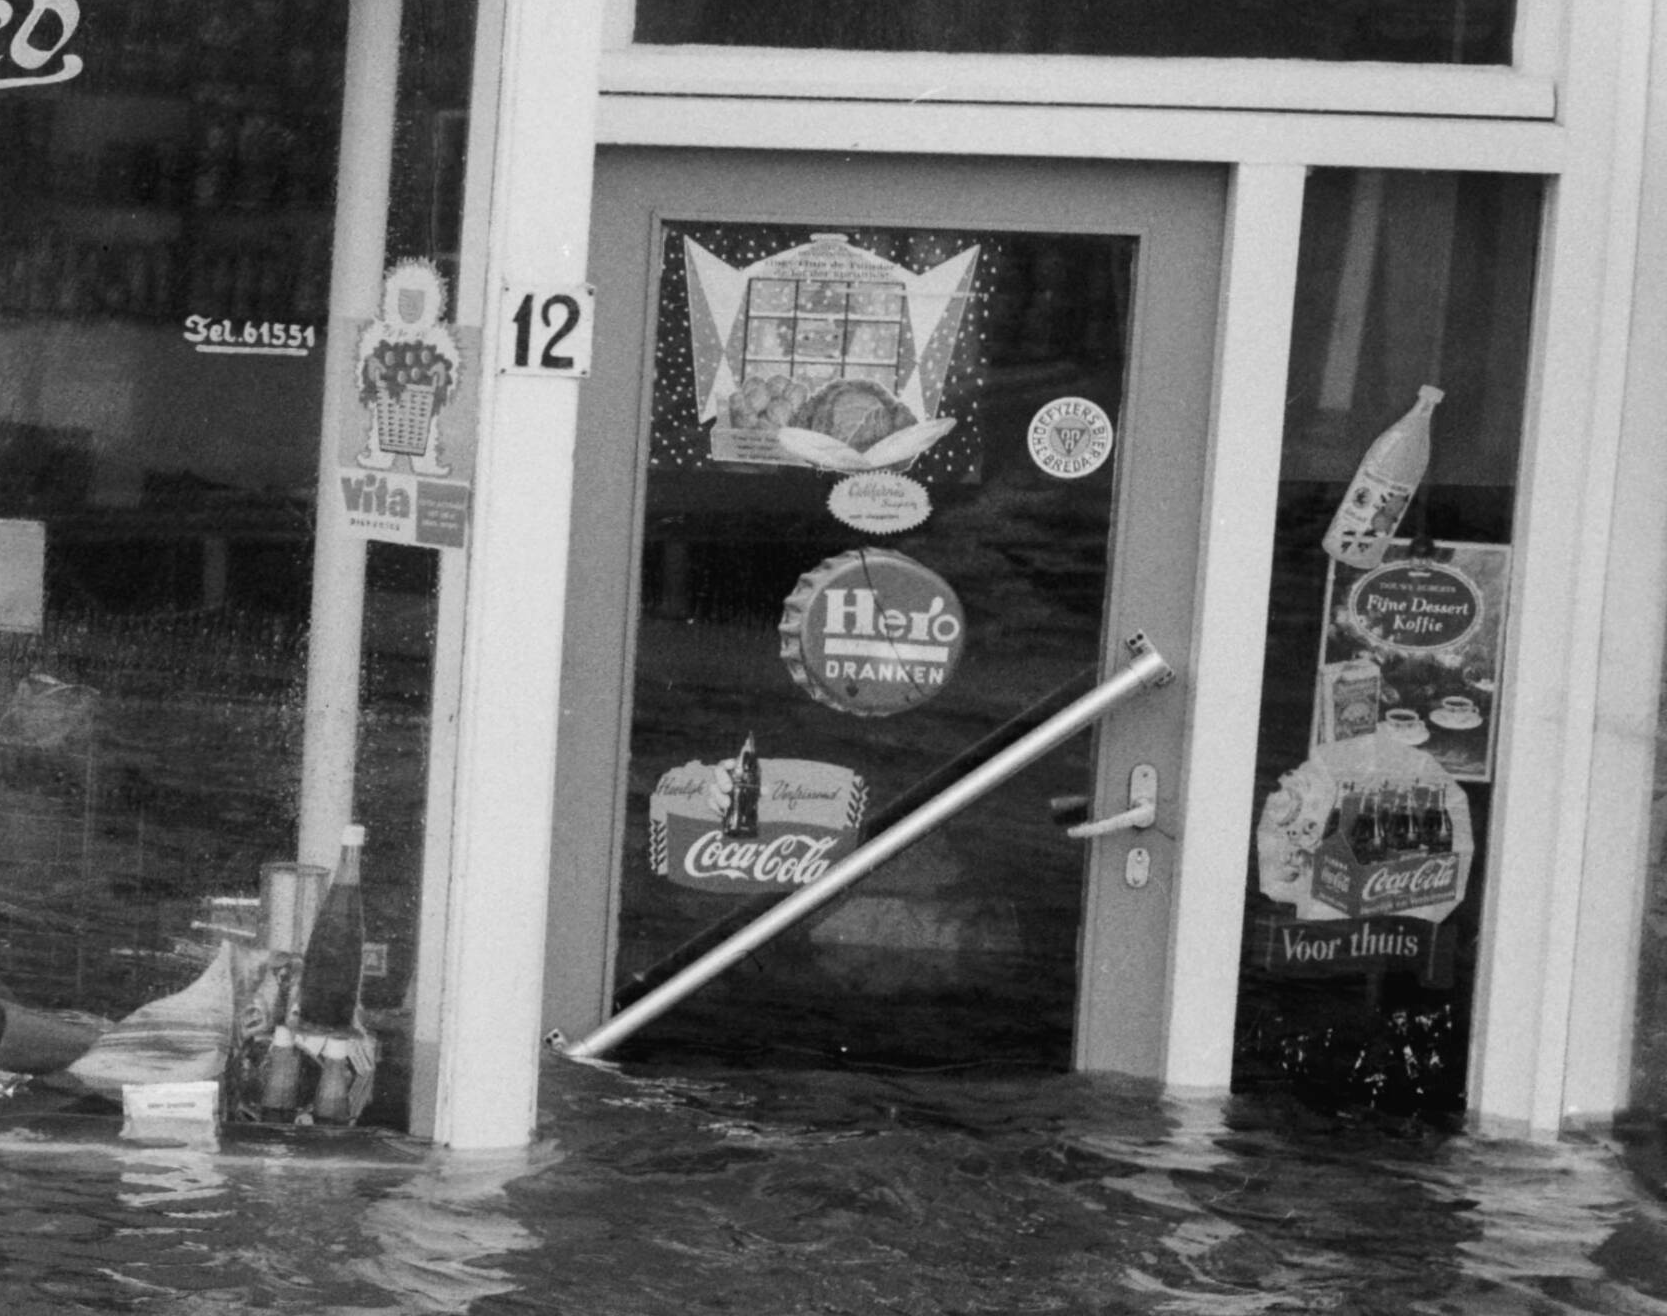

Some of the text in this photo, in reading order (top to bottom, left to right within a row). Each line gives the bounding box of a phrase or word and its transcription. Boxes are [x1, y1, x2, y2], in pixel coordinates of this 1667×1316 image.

[512, 293, 581, 370] 12
[1043, 454, 1094, 473] BREDA
[823, 588, 960, 642] Hero
[1366, 594, 1469, 616] Fijne Dessert
[1393, 614, 1443, 634] Koffie
[825, 660, 945, 685] DRANKEN
[684, 830, 839, 884] Coca-Cola
[1362, 856, 1458, 902] Coca-Cola
[1283, 923, 1419, 963] Voor thuis
